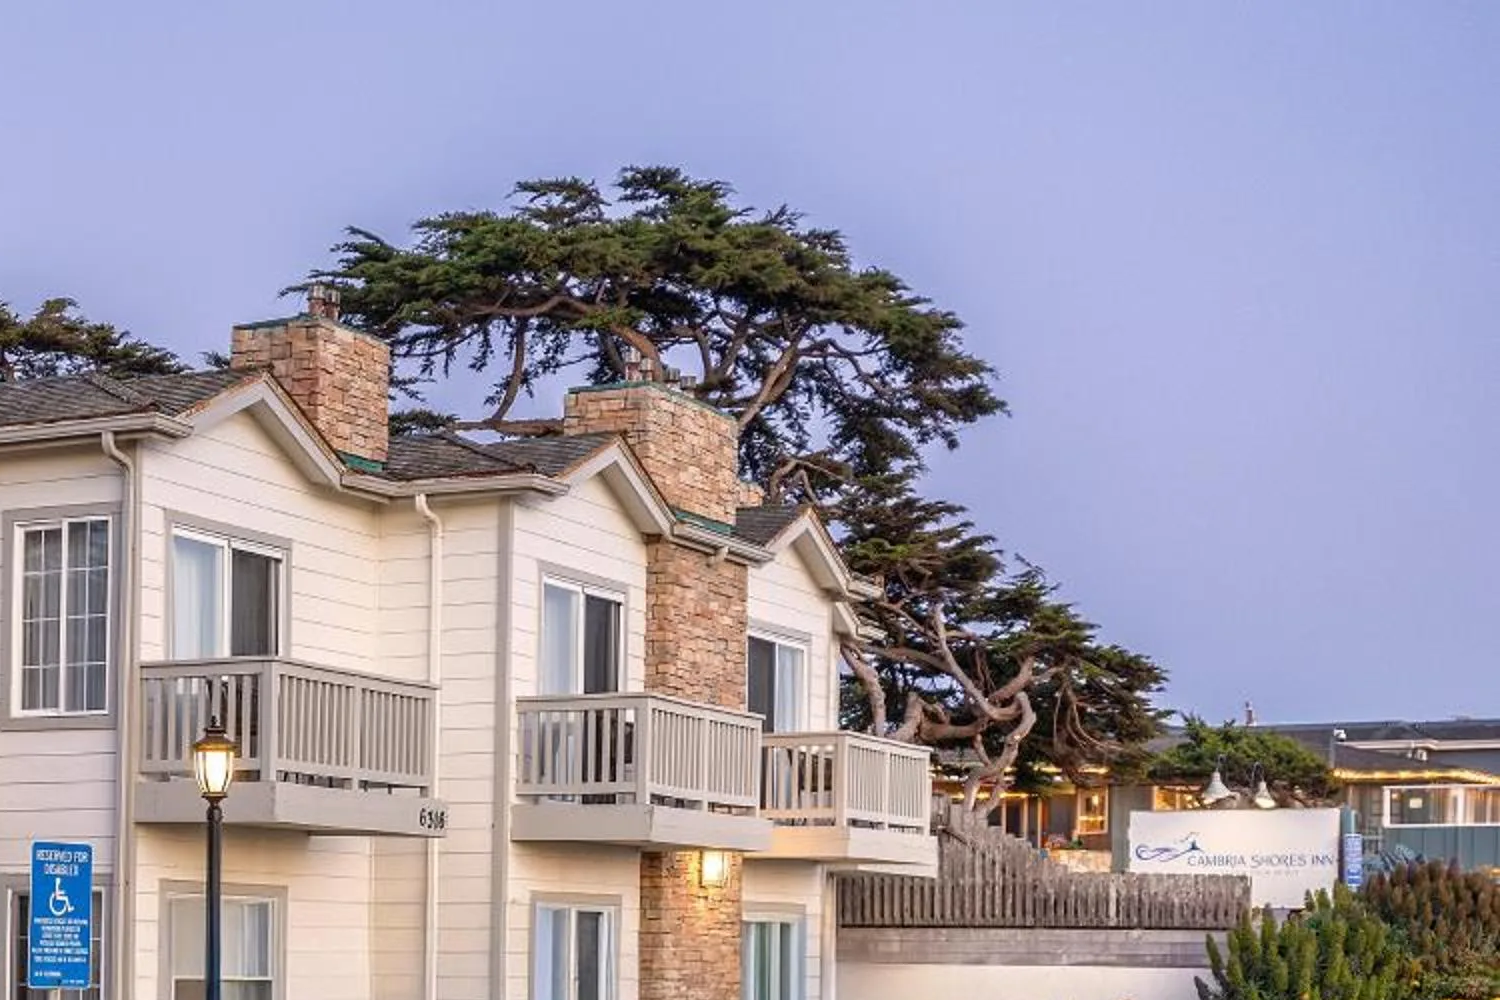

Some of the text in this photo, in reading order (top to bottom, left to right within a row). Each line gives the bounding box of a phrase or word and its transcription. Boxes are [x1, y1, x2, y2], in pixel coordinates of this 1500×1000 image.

[1187, 854, 1335, 869] CAMBRIA SHORES INN
